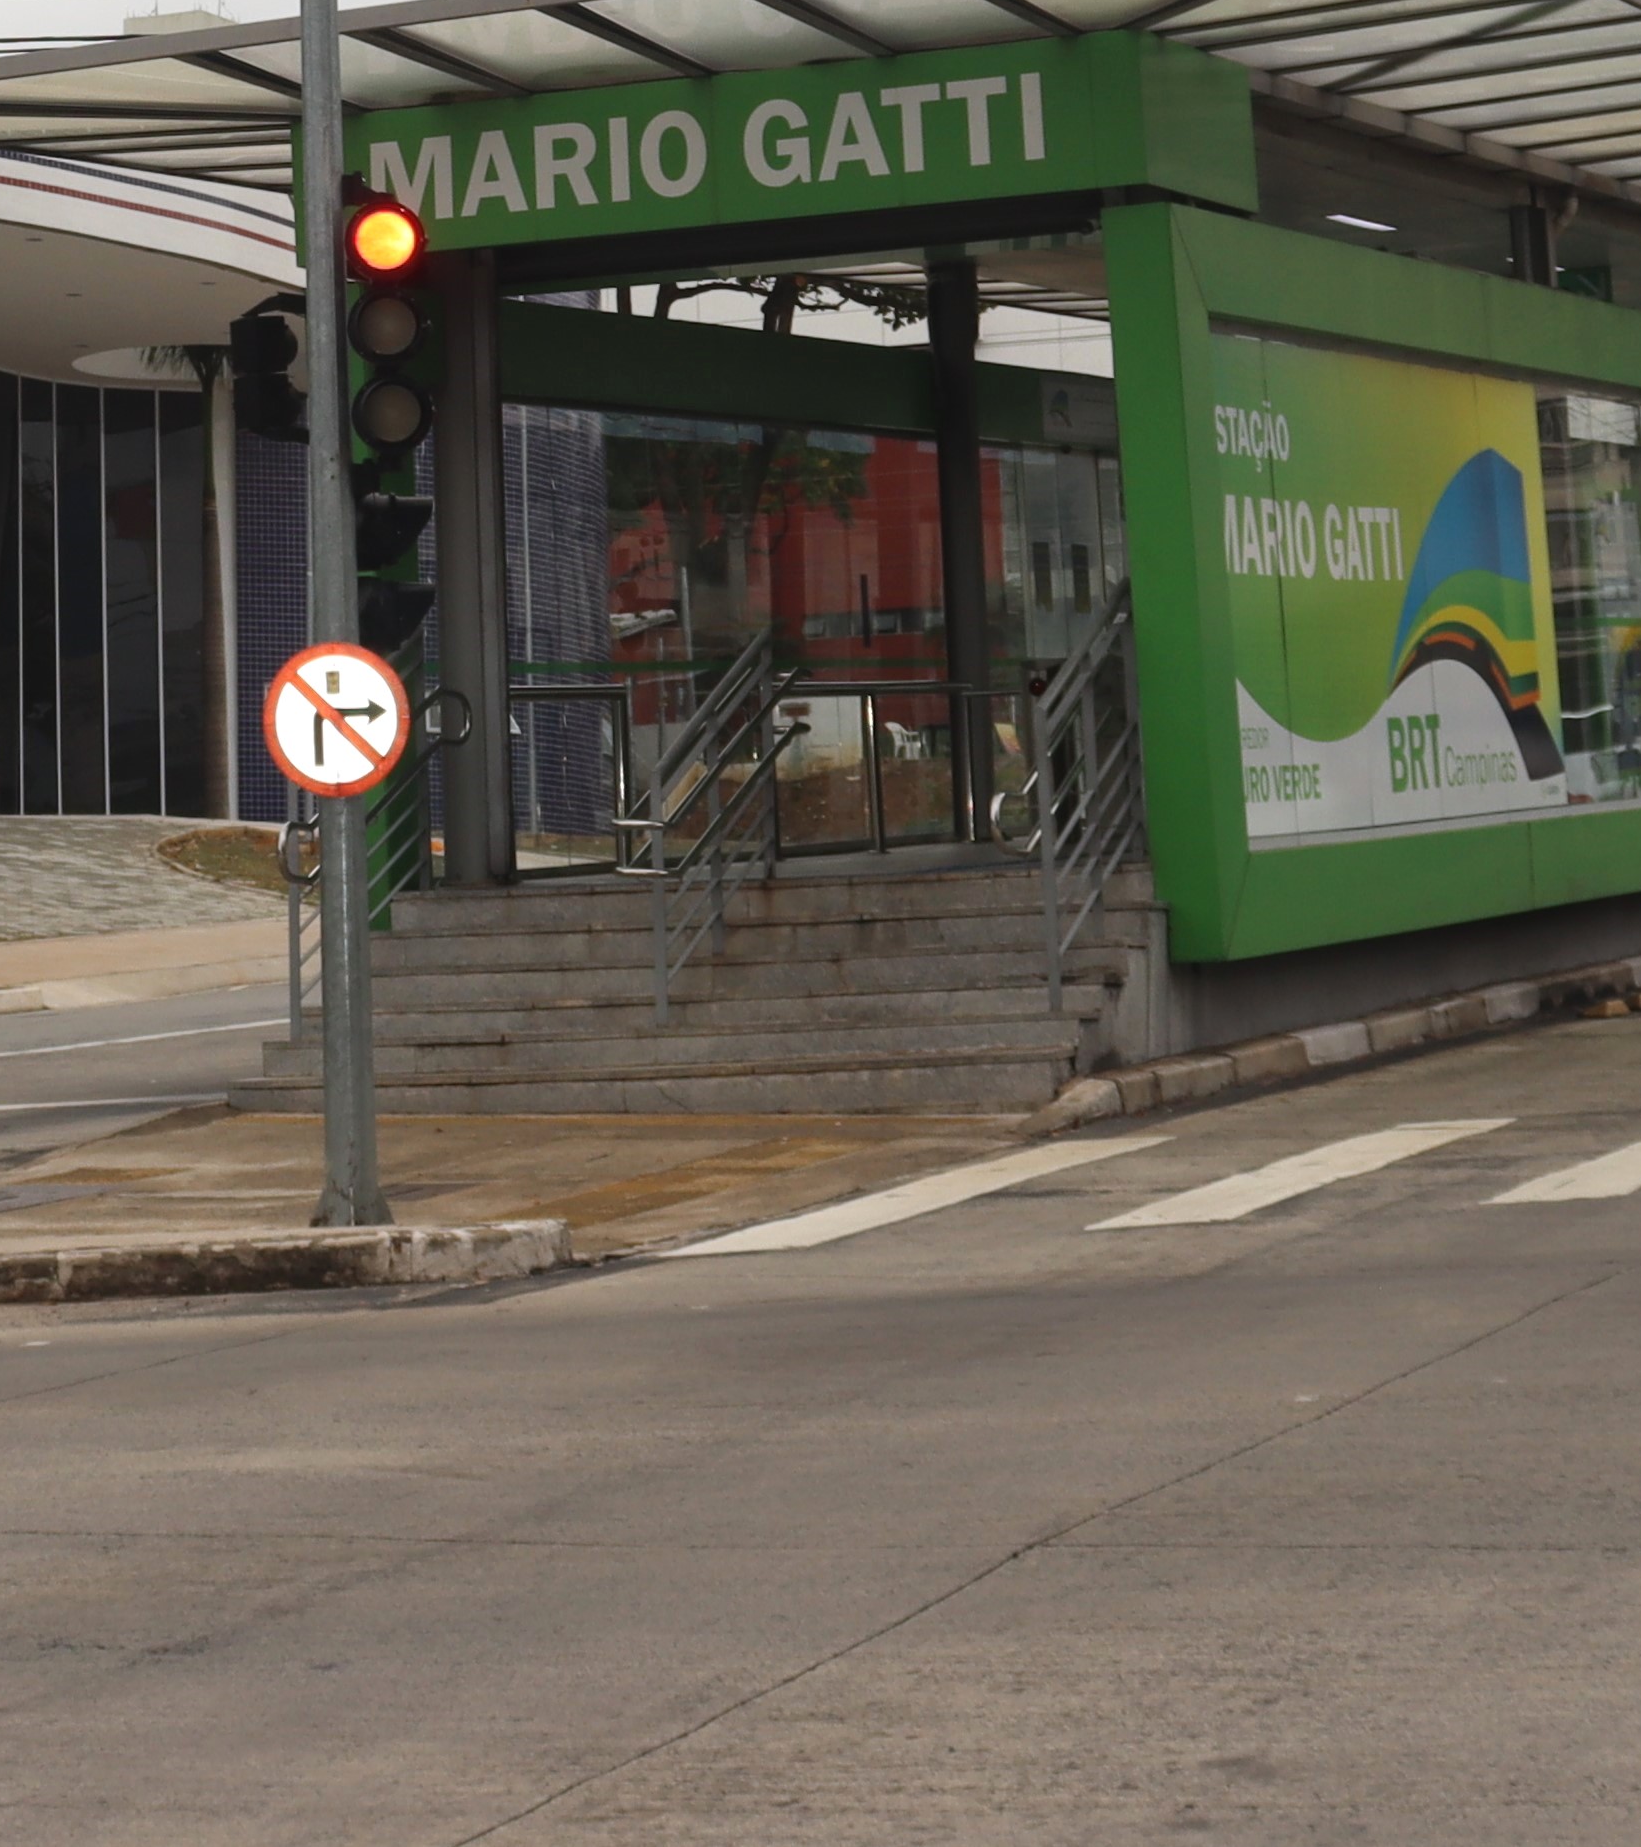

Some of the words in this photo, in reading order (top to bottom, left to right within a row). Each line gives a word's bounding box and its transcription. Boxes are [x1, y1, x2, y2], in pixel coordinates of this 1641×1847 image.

[369, 110, 707, 220] MARIO
[743, 72, 1046, 188] GATTI
[1324, 503, 1404, 581] GATTI
[1272, 763, 1322, 802] VERDE
[1387, 714, 1441, 793] BRT
[1445, 743, 1519, 792] Campinas
